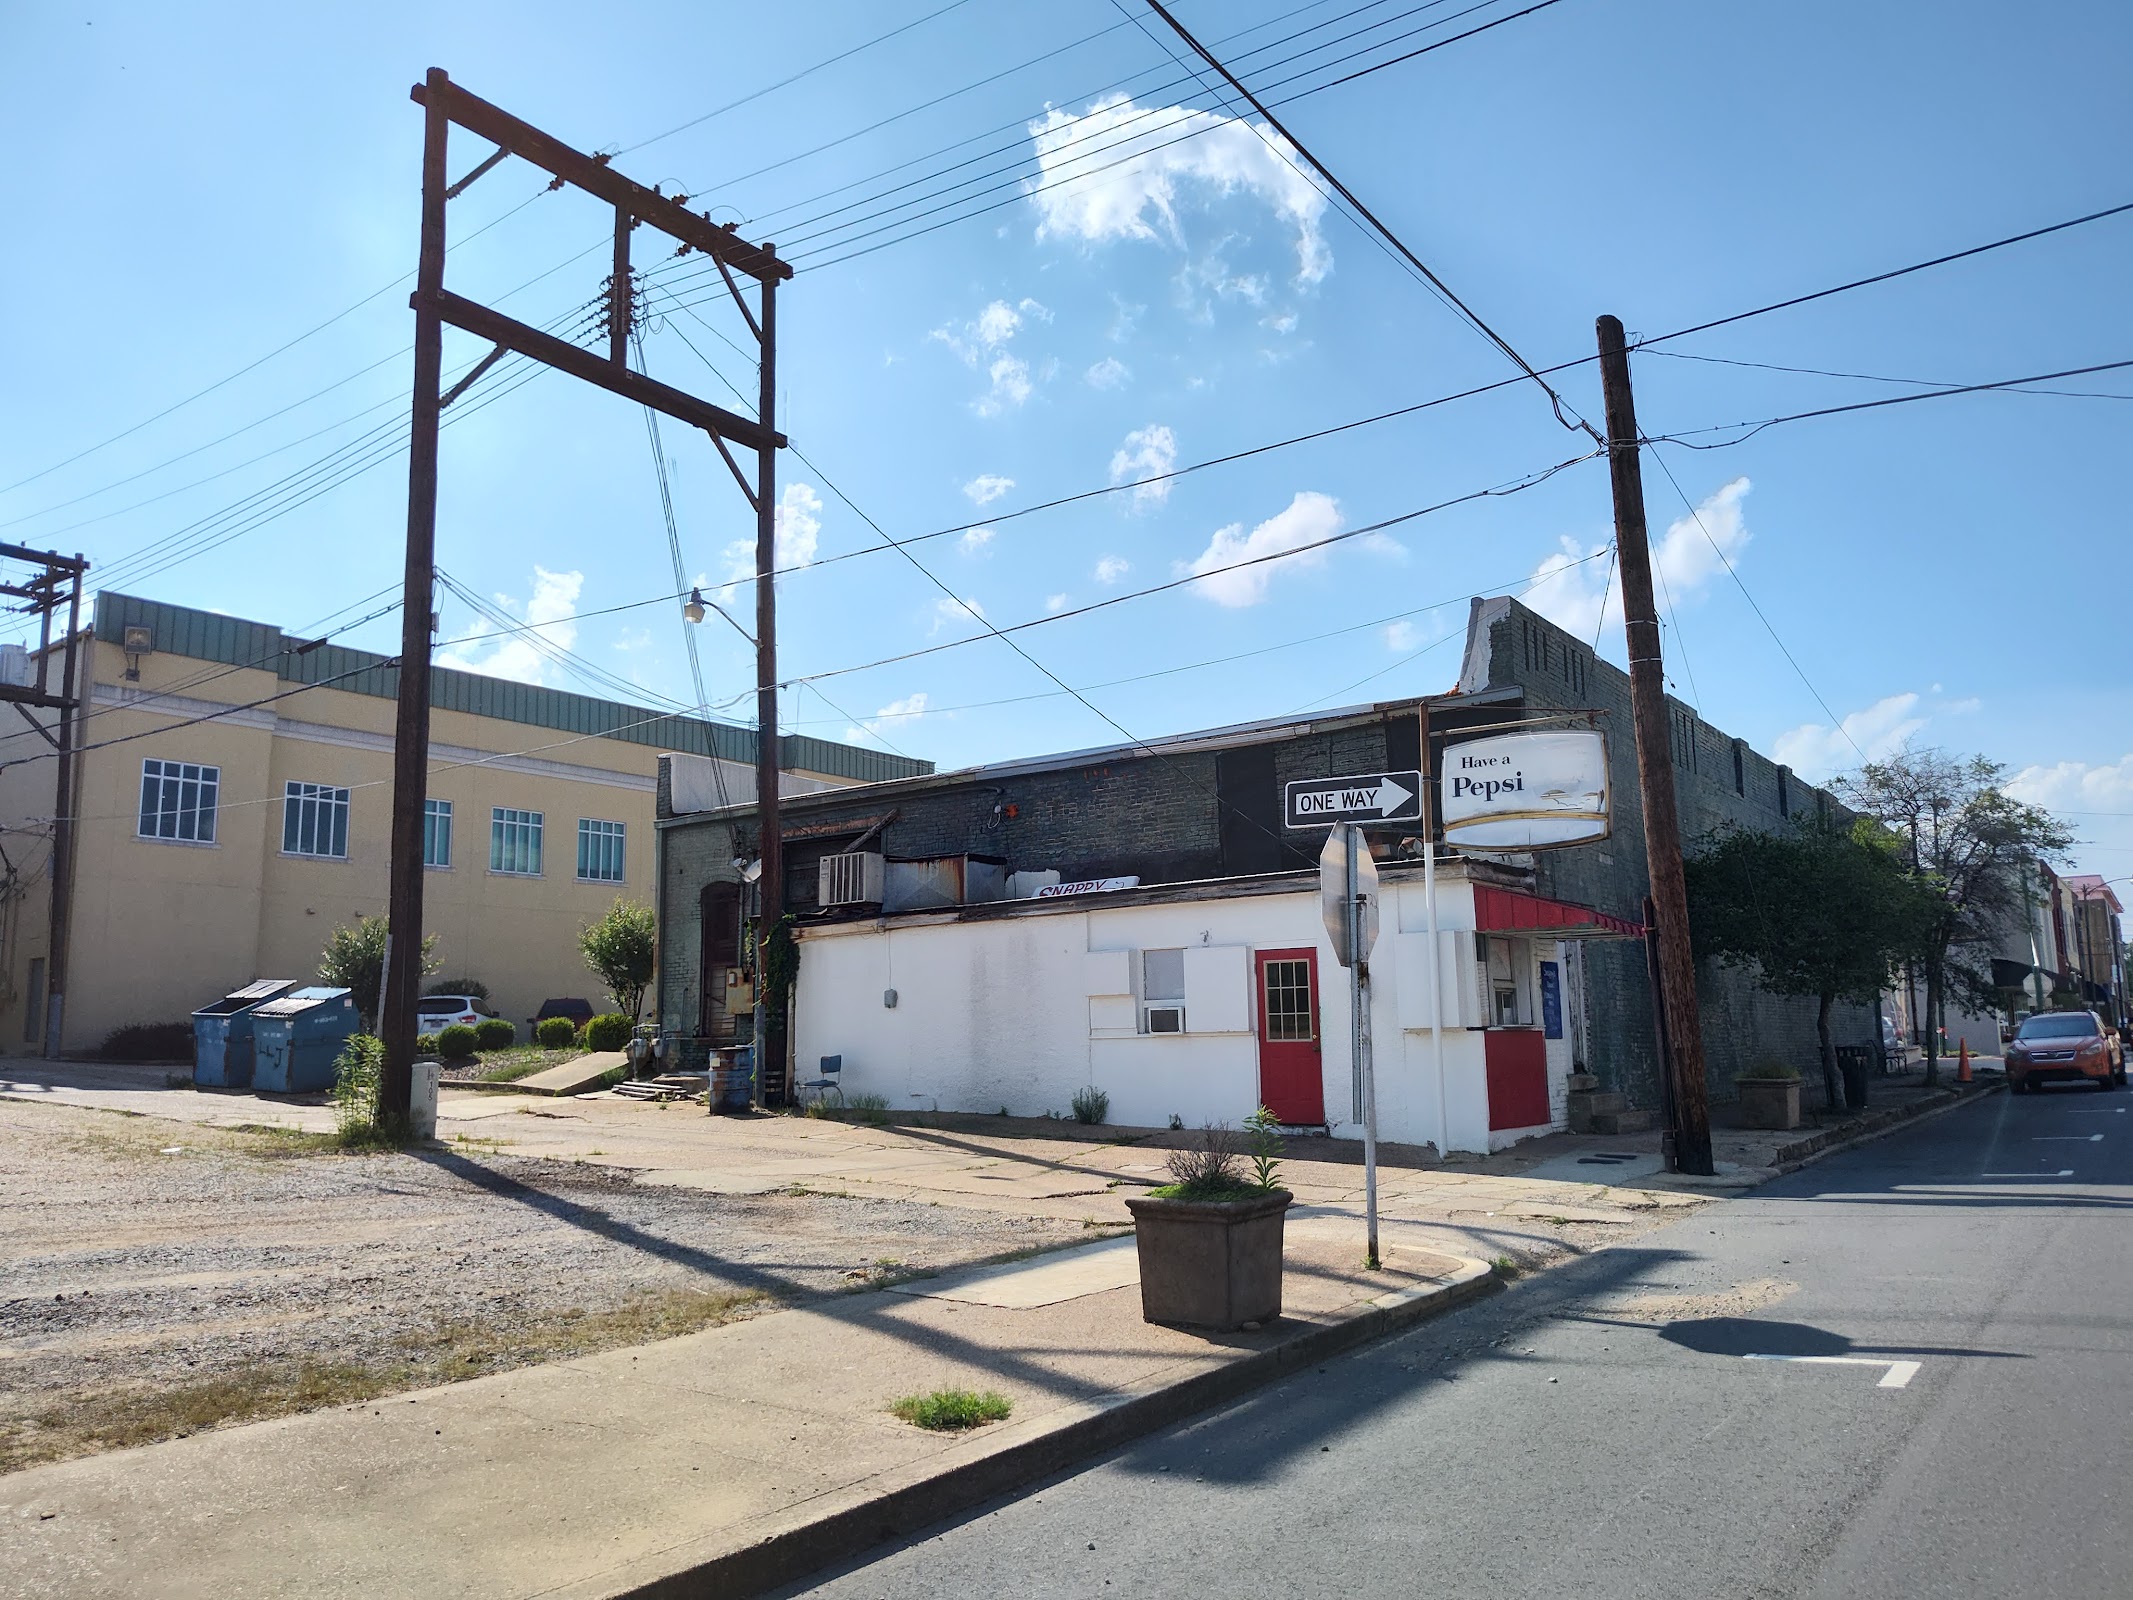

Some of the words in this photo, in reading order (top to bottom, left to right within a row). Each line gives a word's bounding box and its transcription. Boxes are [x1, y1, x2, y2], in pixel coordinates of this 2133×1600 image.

[1461, 756, 1497, 769] Have
[1501, 756, 1510, 766] a
[1452, 771, 1524, 801] Pepsi
[1301, 793, 1335, 811] ONE
[1341, 789, 1378, 809] WAY
